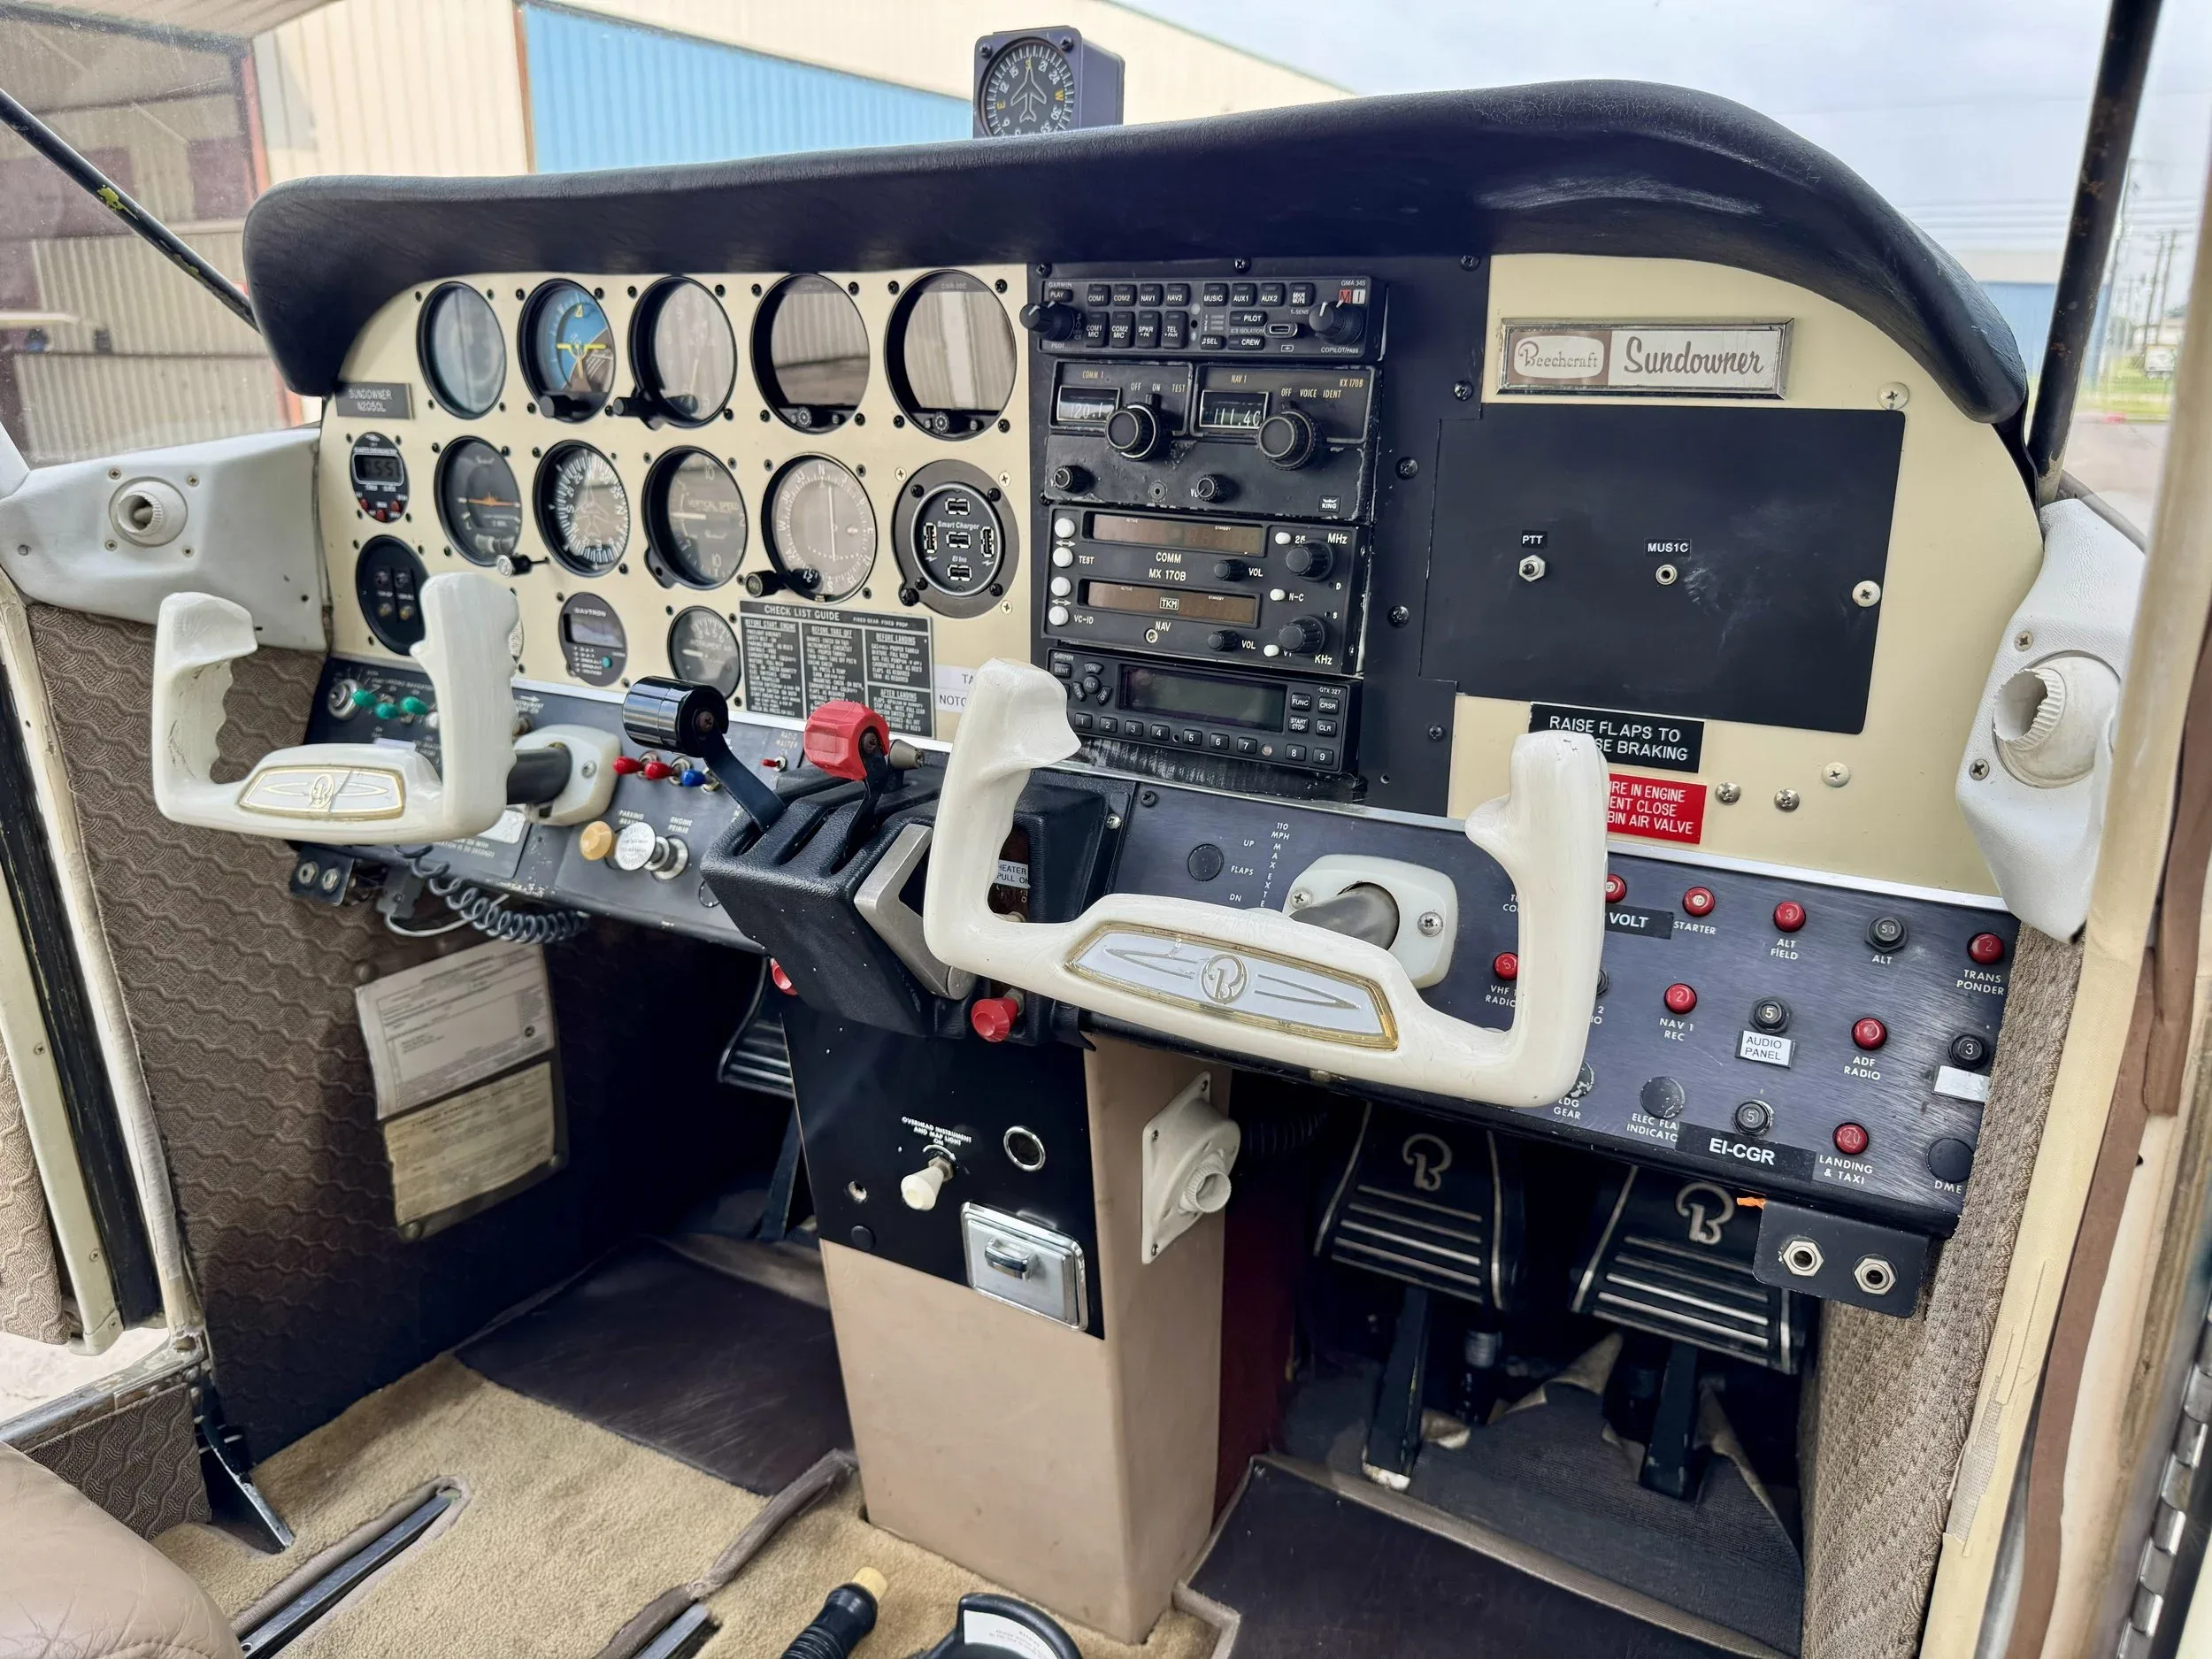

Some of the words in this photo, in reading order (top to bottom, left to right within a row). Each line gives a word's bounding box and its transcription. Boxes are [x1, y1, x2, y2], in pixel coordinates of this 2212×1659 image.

[1048, 70, 1060, 85] 24
[1518, 340, 1598, 369] Beechcraft
[1624, 336, 1763, 375] Sundowner
[1082, 370, 1098, 379] COMM
[1231, 375, 1243, 383] NAV
[1130, 383, 1141, 392] OFF
[1152, 384, 1161, 392] ON
[1172, 384, 1186, 393] TEST
[1339, 378, 1348, 388] KX
[1349, 379, 1364, 388] 170B
[349, 388, 392, 399] SUNDOWNER
[1281, 388, 1291, 397] OFF
[1299, 389, 1317, 398] VOICE
[1323, 389, 1341, 399] IDENT
[705, 469, 715, 481] 10
[818, 464, 825, 476] N
[777, 520, 787, 531] W
[937, 520, 955, 529] Smart
[956, 522, 980, 530] Charger
[1328, 533, 1348, 544] MHz
[1522, 535, 1544, 545] PTT
[712, 553, 722, 568] 10
[1079, 555, 1094, 565] TEST
[1156, 552, 1182, 564] COMM
[1148, 568, 1161, 579] MX
[1165, 570, 1187, 581] 170B
[1248, 568, 1263, 577] VOL
[827, 581, 834, 592] S
[1161, 599, 1178, 609] TKM
[572, 607, 607, 618] DAVTRON
[764, 604, 791, 616] CHECK
[794, 609, 811, 618] LIST
[814, 611, 840, 622] GUIDE
[1074, 614, 1094, 624] VC-ID
[1155, 621, 1171, 632] NAV
[1241, 640, 1256, 650] VOL
[1314, 655, 1333, 665] KHz
[1549, 715, 1595, 733] RAISE
[1599, 720, 1653, 741] FLAPS
[1658, 727, 1681, 742] TO
[1189, 733, 1194, 742] 5
[1617, 740, 1689, 761] BRAKING
[1630, 783, 1642, 797] IN
[1644, 785, 1686, 803] ENGINE
[1636, 800, 1678, 818] CLOSE
[670, 816, 693, 826] ENGINE
[1276, 822, 1289, 831] 110
[1607, 812, 1626, 825] BIN
[1628, 815, 1650, 829] AIR
[1653, 818, 1694, 835] VALVE
[1271, 831, 1290, 841] MPH
[1230, 865, 1254, 876] FLAPS
[997, 872, 1015, 882] PULL
[1260, 872, 1271, 908] EXTE
[1229, 893, 1242, 902] DN
[1694, 896, 1703, 905] 10
[1609, 912, 1649, 928] VOLT
[1673, 921, 1717, 936] STARTER
[1881, 924, 1896, 934] 50
[1777, 938, 1797, 949] ALT
[1985, 940, 1993, 952] 2
[1770, 948, 1799, 961] FIELD
[1872, 954, 1893, 965] ALT
[1963, 968, 2001, 984] TRANS
[1490, 984, 1510, 995] VHF
[1956, 980, 2005, 996] PONDER
[1676, 991, 1684, 1002] 2
[1598, 1006, 1604, 1014] 2
[1765, 1007, 1775, 1018] 5
[1659, 1018, 1683, 1030] NAV
[1688, 1022, 1694, 1032] 1
[1664, 1030, 1685, 1041] REC
[1746, 1036, 1783, 1049] AUDIO
[1745, 1047, 1782, 1061] PANEL
[1965, 1044, 1974, 1055] 3
[1853, 1056, 1877, 1068] ADF
[1843, 1065, 1881, 1081] RADIO
[1553, 1106, 1582, 1119] GEAR
[1747, 1111, 1755, 1122] 5
[1632, 1113, 1655, 1126] ELEC
[901, 1116, 934, 1131] OVERHEAD
[935, 1126, 972, 1143] INSTRUMENT
[1626, 1123, 1678, 1143] INDICATO
[913, 1125, 928, 1136] AND
[929, 1130, 944, 1140] MAP
[944, 1135, 962, 1147] LIGHT
[933, 1138, 944, 1146] ON
[1709, 1137, 1776, 1166] EI-CGR
[1819, 1154, 1874, 1175] LANDING
[1824, 1168, 1832, 1177] &
[1838, 1170, 1866, 1185] TAXI
[1934, 1180, 1963, 1194] DME
